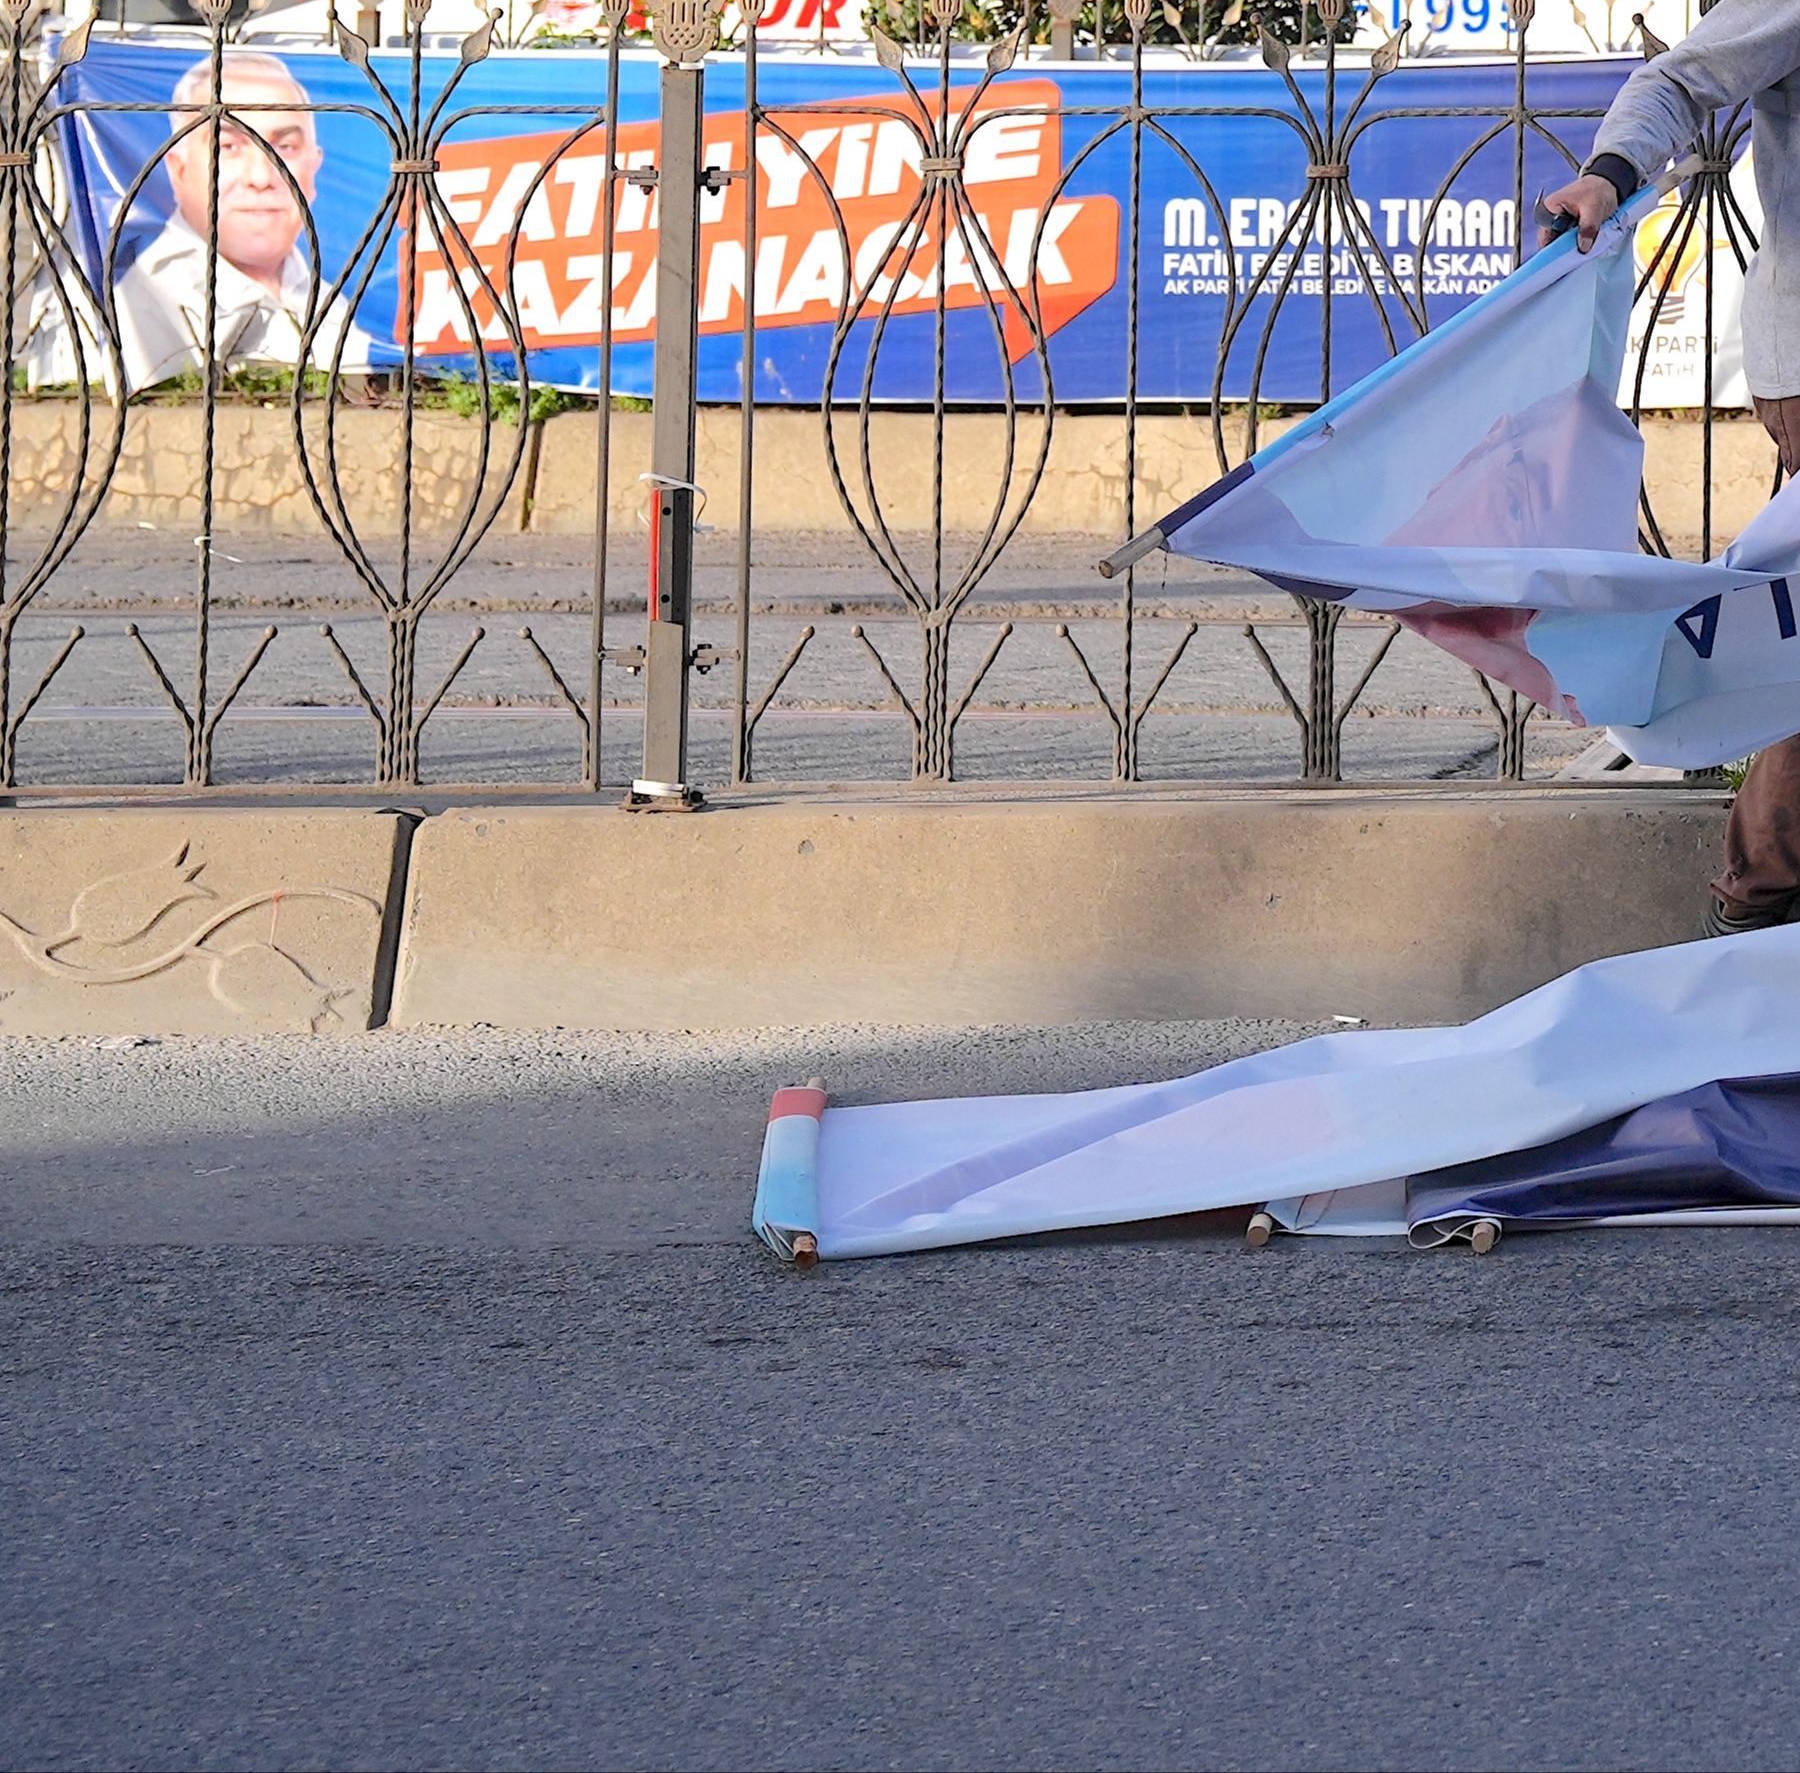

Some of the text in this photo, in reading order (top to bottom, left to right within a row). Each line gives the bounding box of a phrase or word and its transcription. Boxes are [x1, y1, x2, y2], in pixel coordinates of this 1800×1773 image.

[756, 104, 1048, 209] YİNE
[1164, 197, 1220, 248] M.
[1380, 198, 1517, 248] TURAN
[1163, 248, 1243, 277] FATİH
[1250, 248, 1386, 277] BELEDİYE
[1163, 278, 1190, 295] AK
